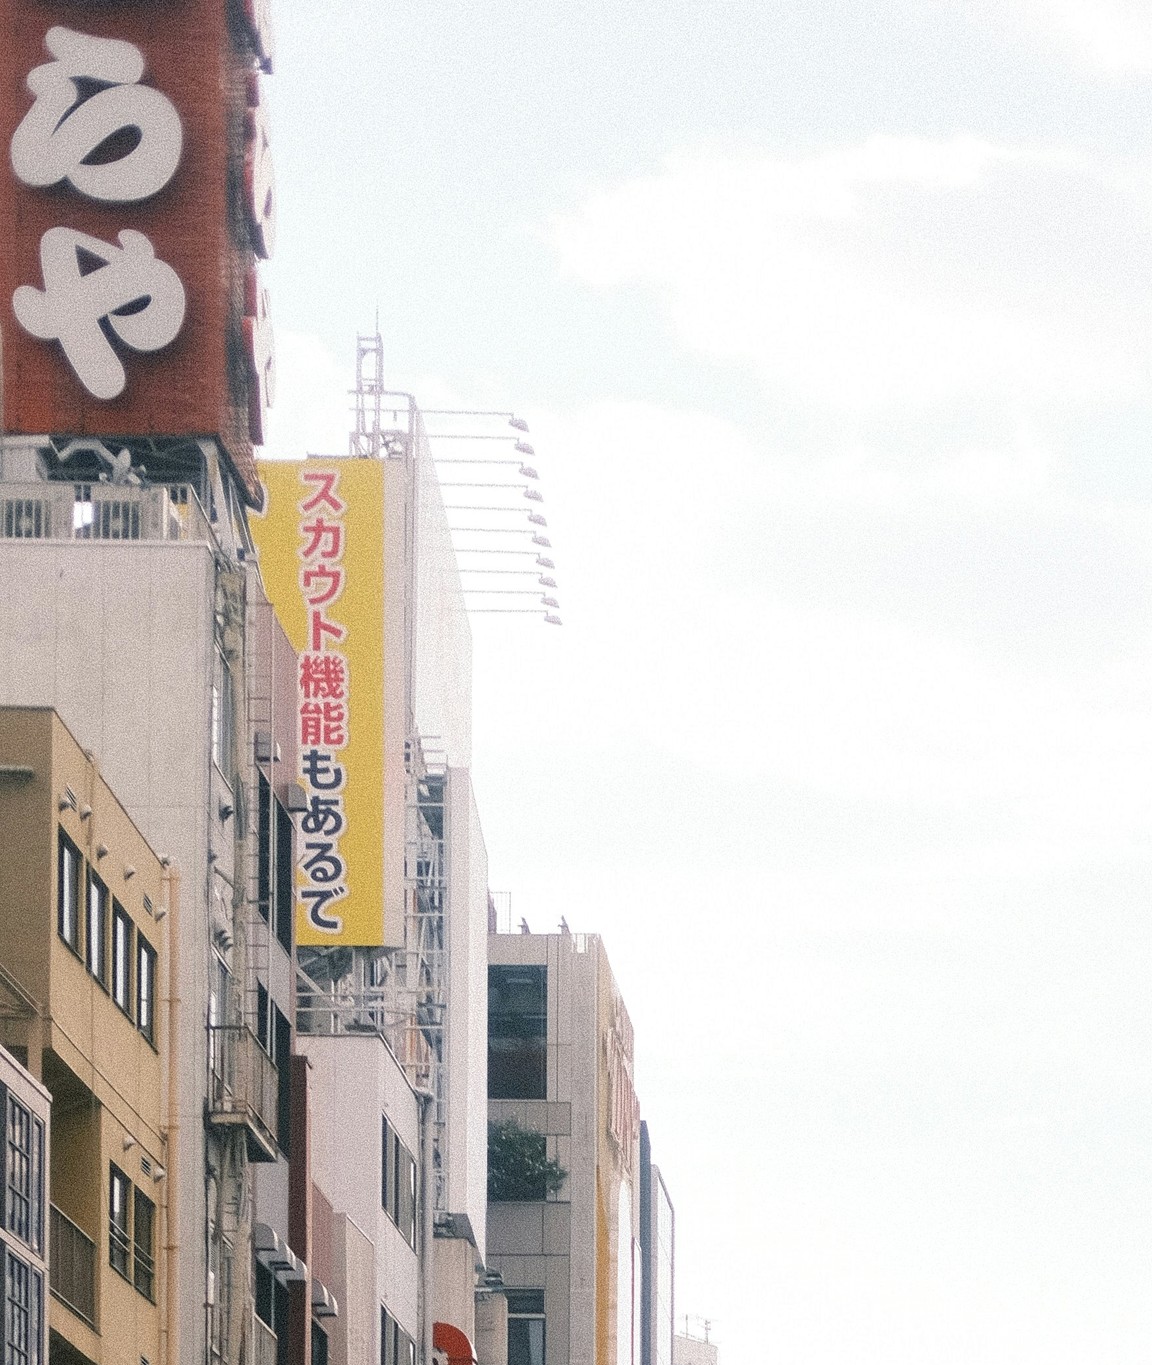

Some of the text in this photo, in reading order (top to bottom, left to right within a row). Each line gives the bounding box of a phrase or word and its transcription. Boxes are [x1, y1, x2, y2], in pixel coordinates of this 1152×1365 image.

[300, 469, 346, 934] スカウト機能もあるで
